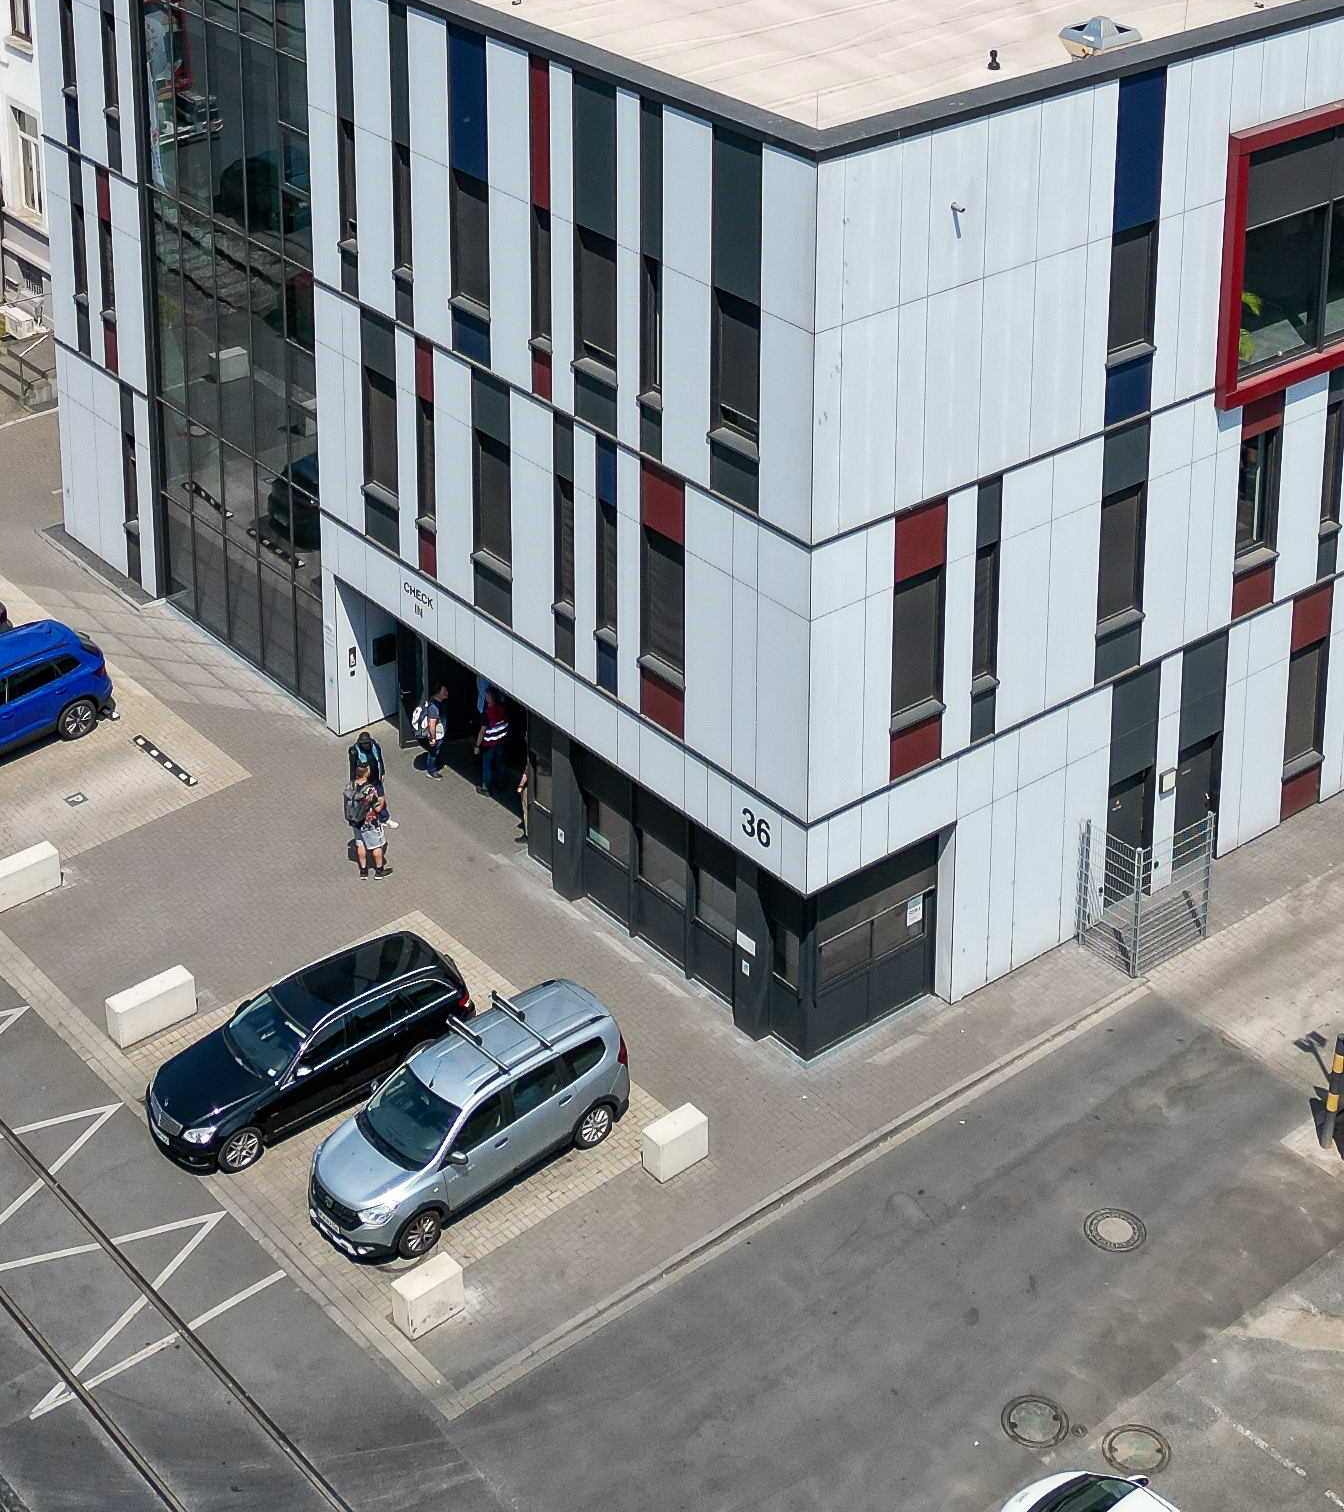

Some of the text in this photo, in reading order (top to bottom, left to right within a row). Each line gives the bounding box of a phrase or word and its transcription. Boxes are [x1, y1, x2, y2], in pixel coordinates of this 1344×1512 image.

[403, 582, 433, 610] CHECK
[414, 604, 423, 618] IN
[741, 807, 771, 848] 36
